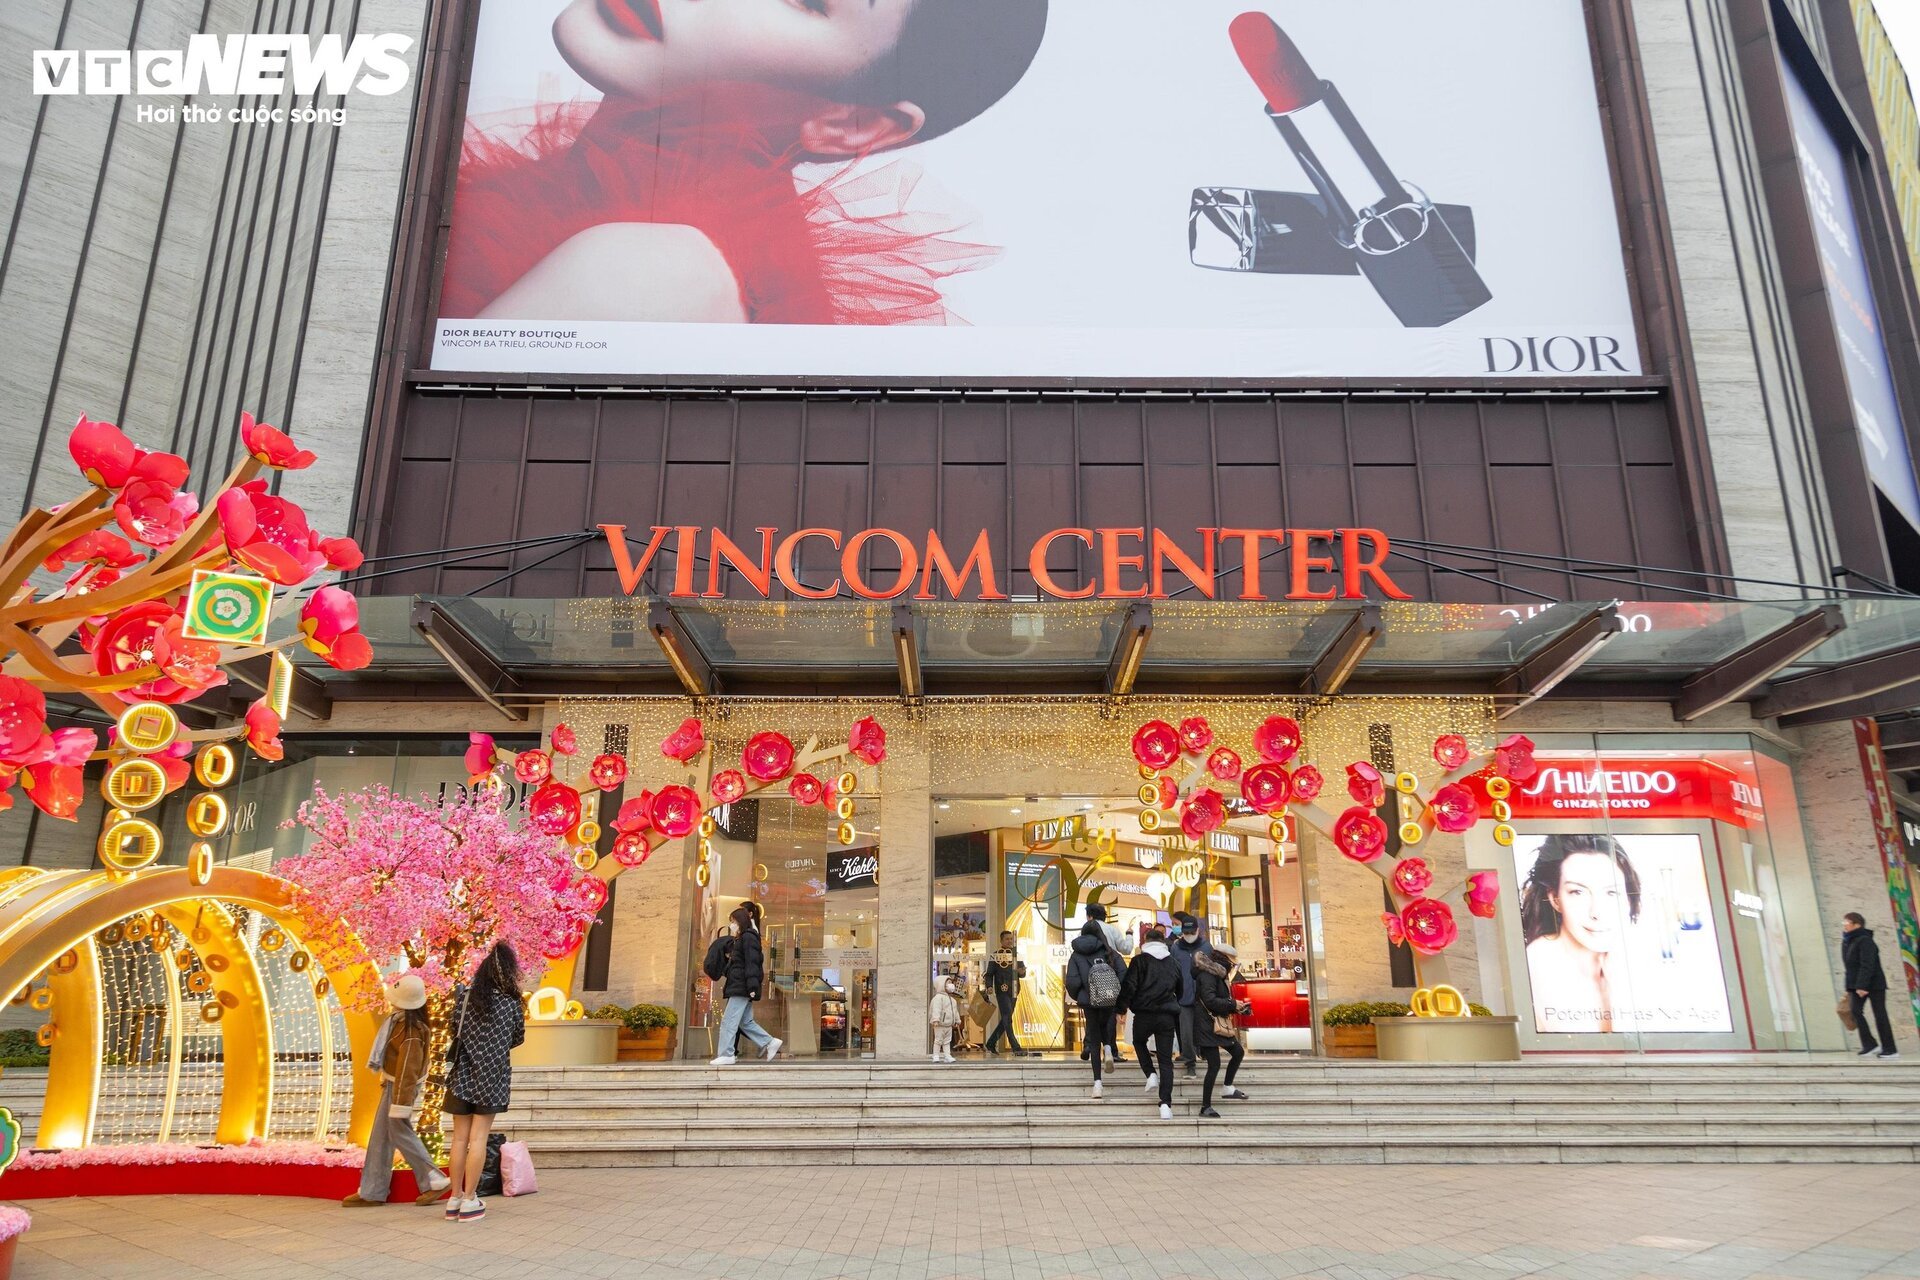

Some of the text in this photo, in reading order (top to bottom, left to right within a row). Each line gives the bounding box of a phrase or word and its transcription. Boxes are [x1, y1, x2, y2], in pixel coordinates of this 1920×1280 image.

[442, 329, 577, 339] DIOR BEAUTY BOUTIQUE
[441, 339, 608, 349] VINCOM BA TRIEU, GROUND FLOOR
[1479, 336, 1631, 373] DIOR
[596, 524, 1414, 600] VINCOM CENTER
[1553, 799, 1651, 809] GINZA TOKYO
[839, 856, 878, 879] Kiehl's
[1544, 1007, 1721, 1024] Potential Has No Age
